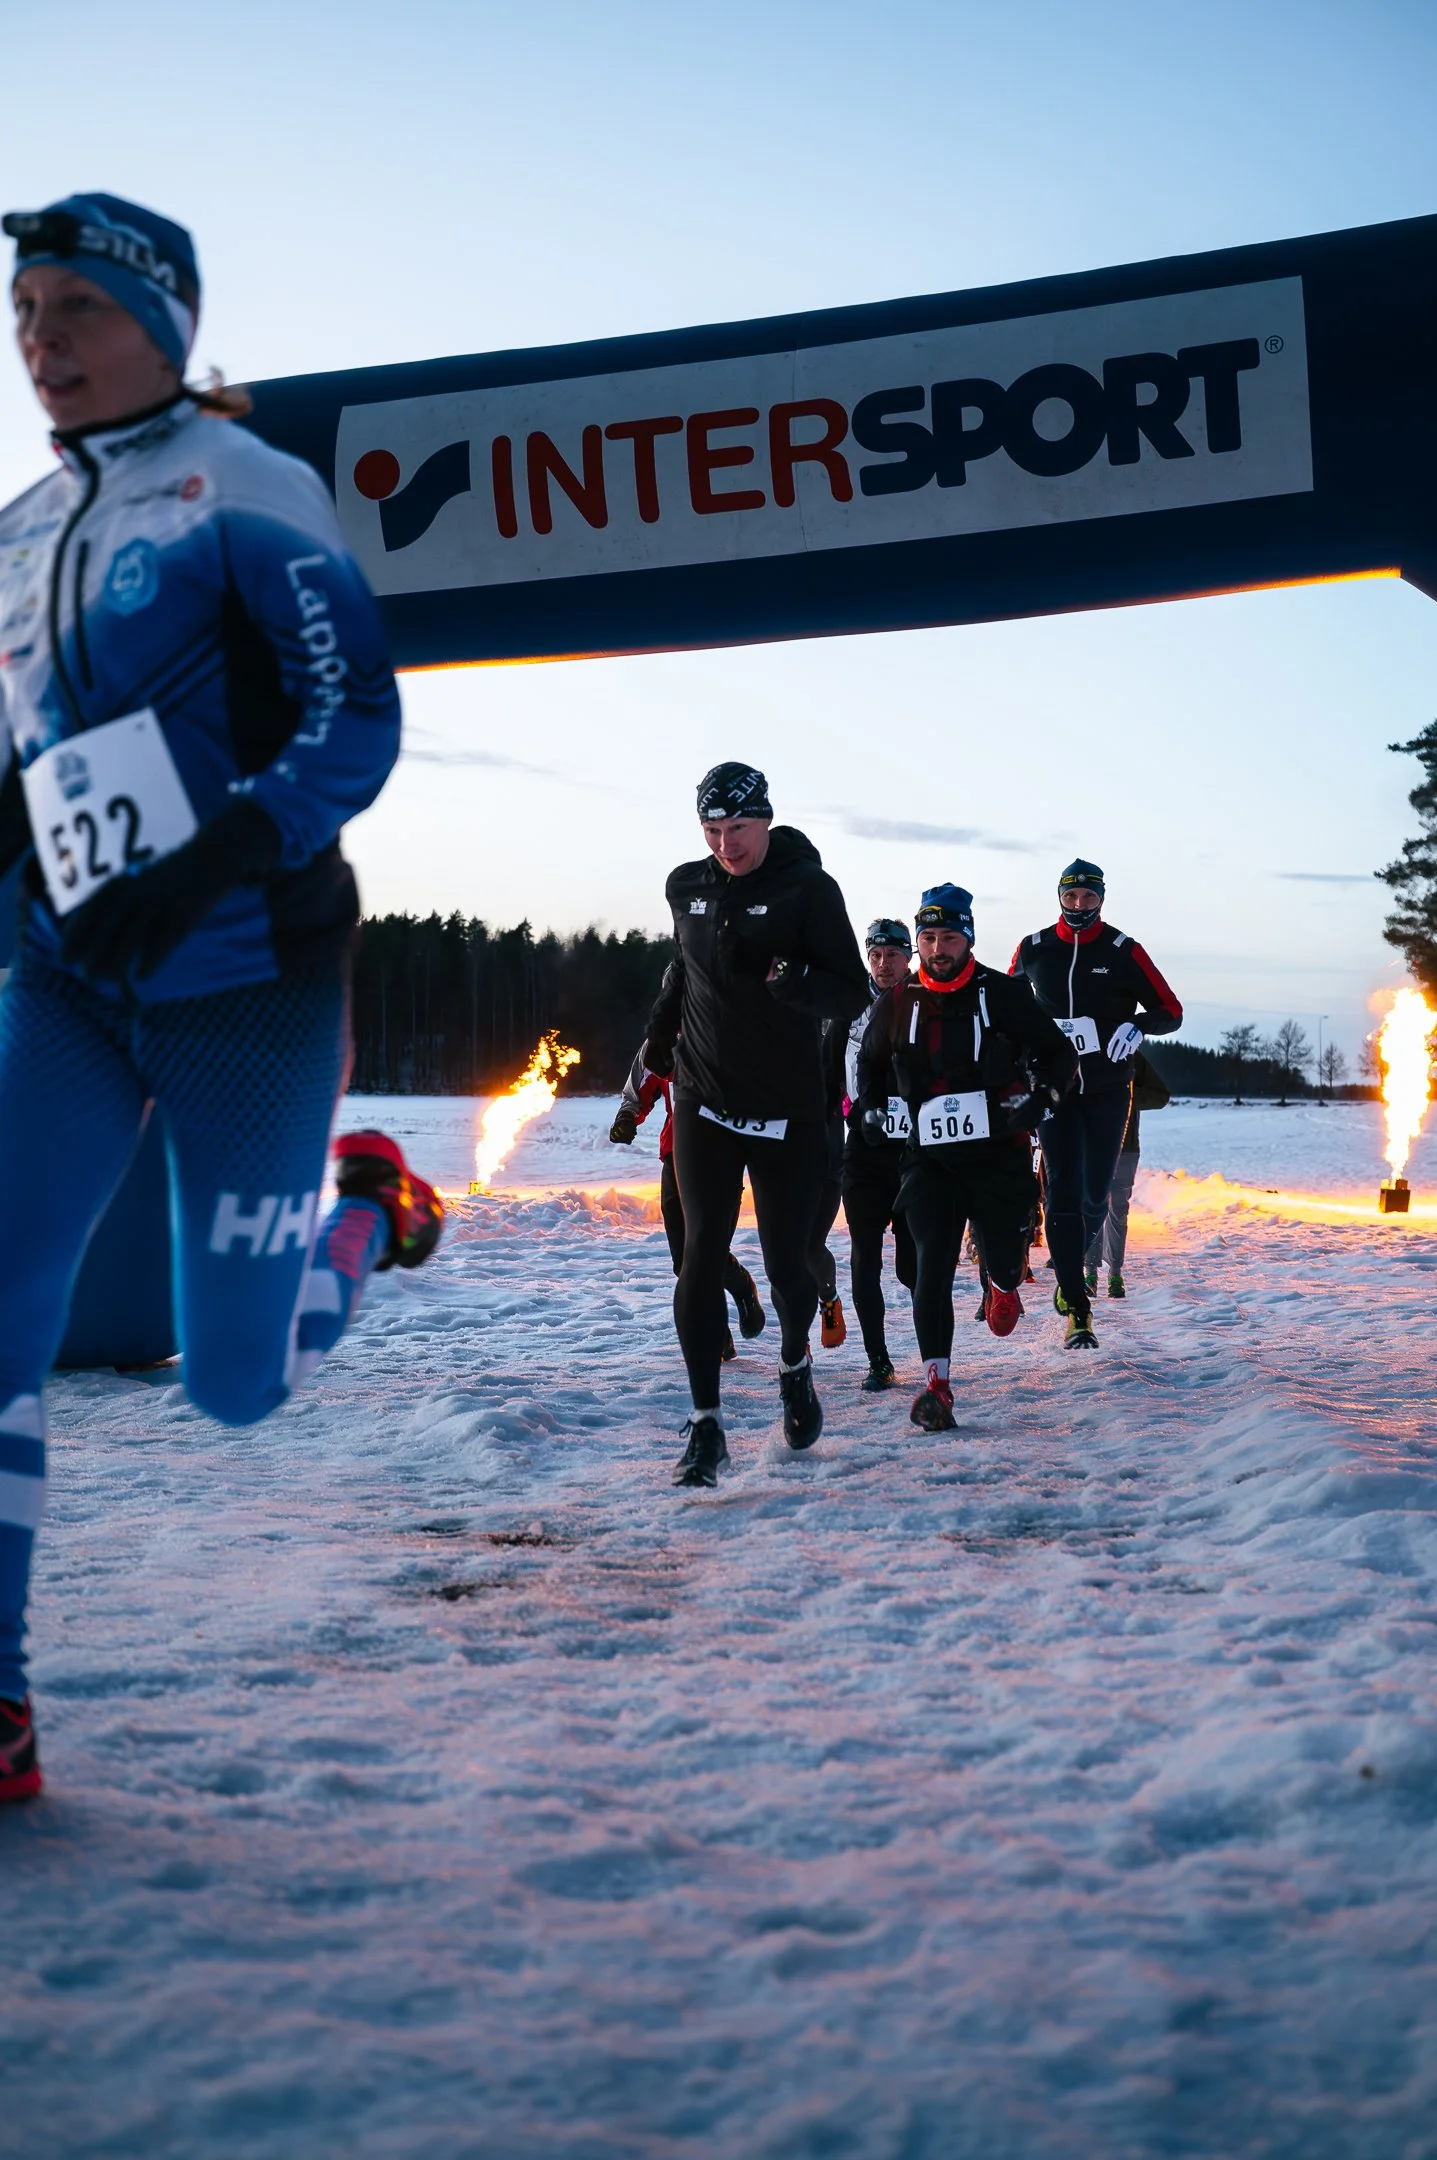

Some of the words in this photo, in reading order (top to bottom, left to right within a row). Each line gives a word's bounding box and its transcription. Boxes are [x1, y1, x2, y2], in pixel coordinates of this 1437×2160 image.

[491, 337, 1260, 540] INTERSPORT
[50, 794, 154, 889] 522
[886, 1115, 909, 1134] 04
[930, 1114, 974, 1139] 506
[209, 1190, 317, 1257] HH
